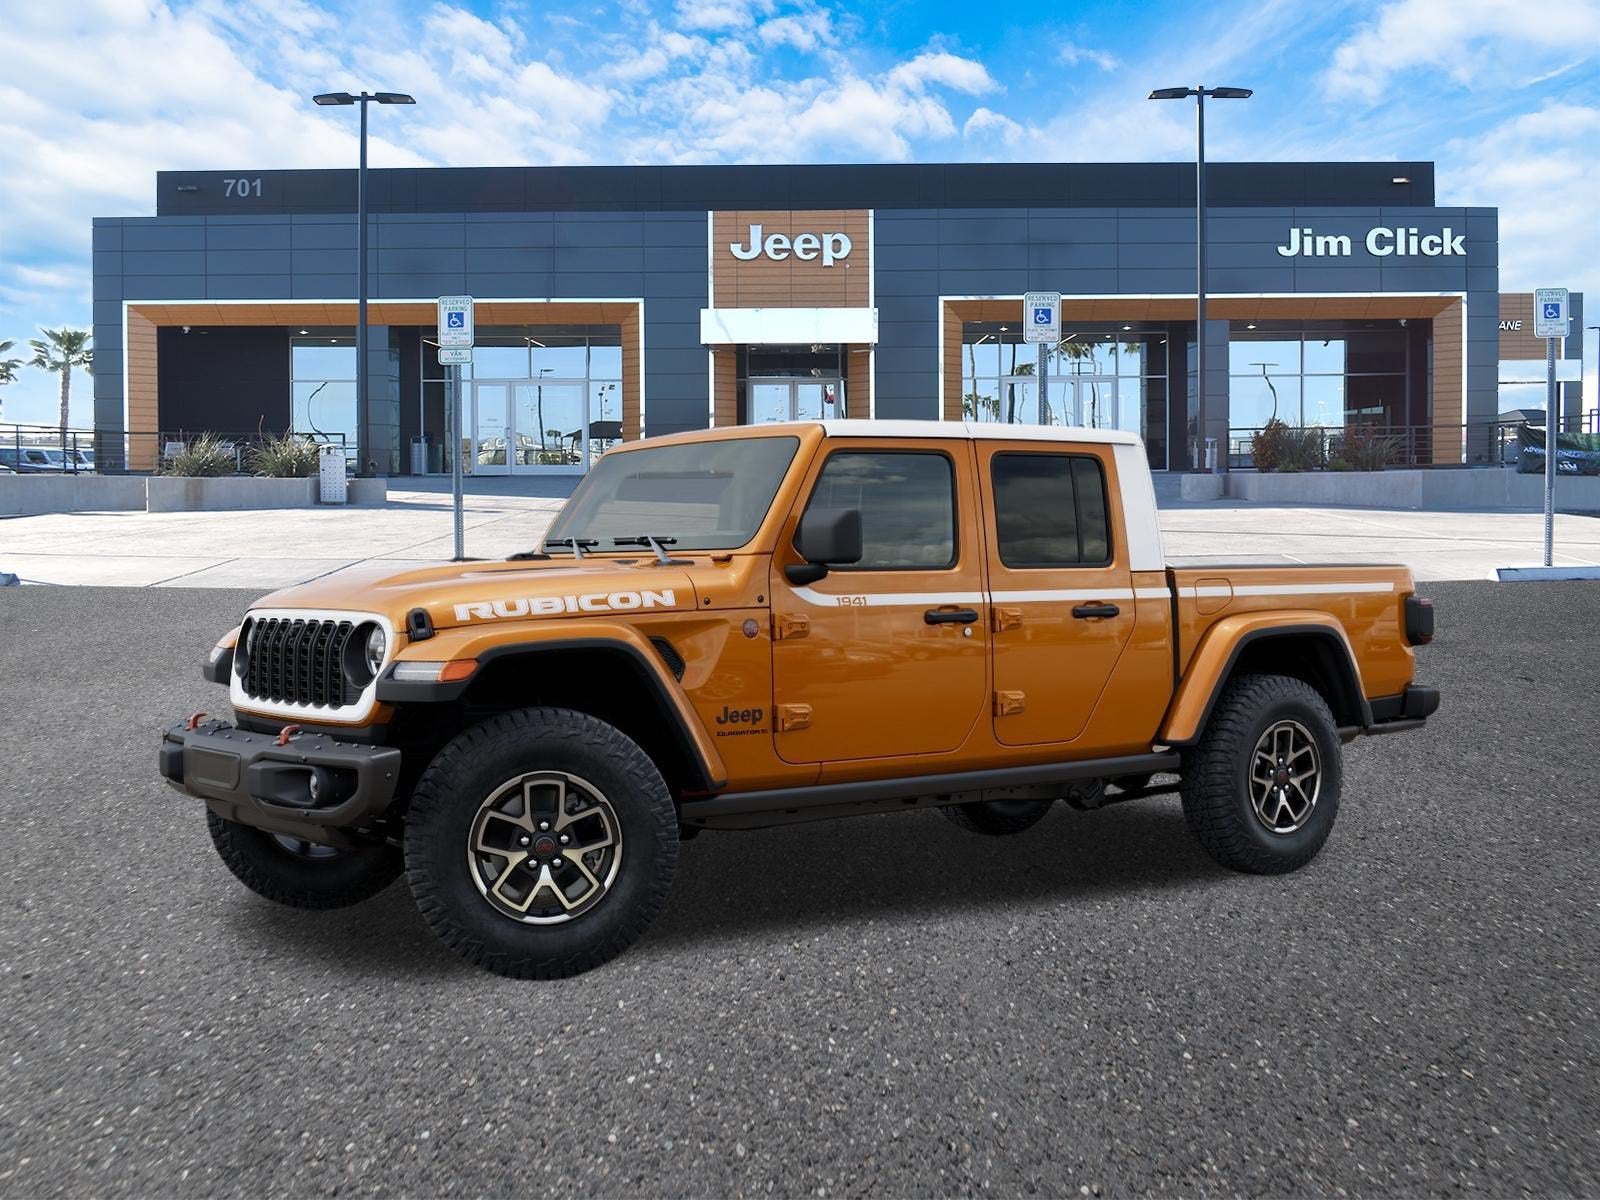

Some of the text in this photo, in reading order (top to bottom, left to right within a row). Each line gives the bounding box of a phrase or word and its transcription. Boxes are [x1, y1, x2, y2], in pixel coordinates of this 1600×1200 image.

[223, 178, 262, 198] 701
[729, 223, 852, 268] Jeep
[1277, 226, 1468, 257] Jim Click
[1499, 321, 1522, 330] ANE
[453, 590, 676, 621] RUBICON
[836, 596, 867, 607] 1941
[715, 705, 764, 726] Jeep
[716, 729, 760, 737] GLADIATOR
